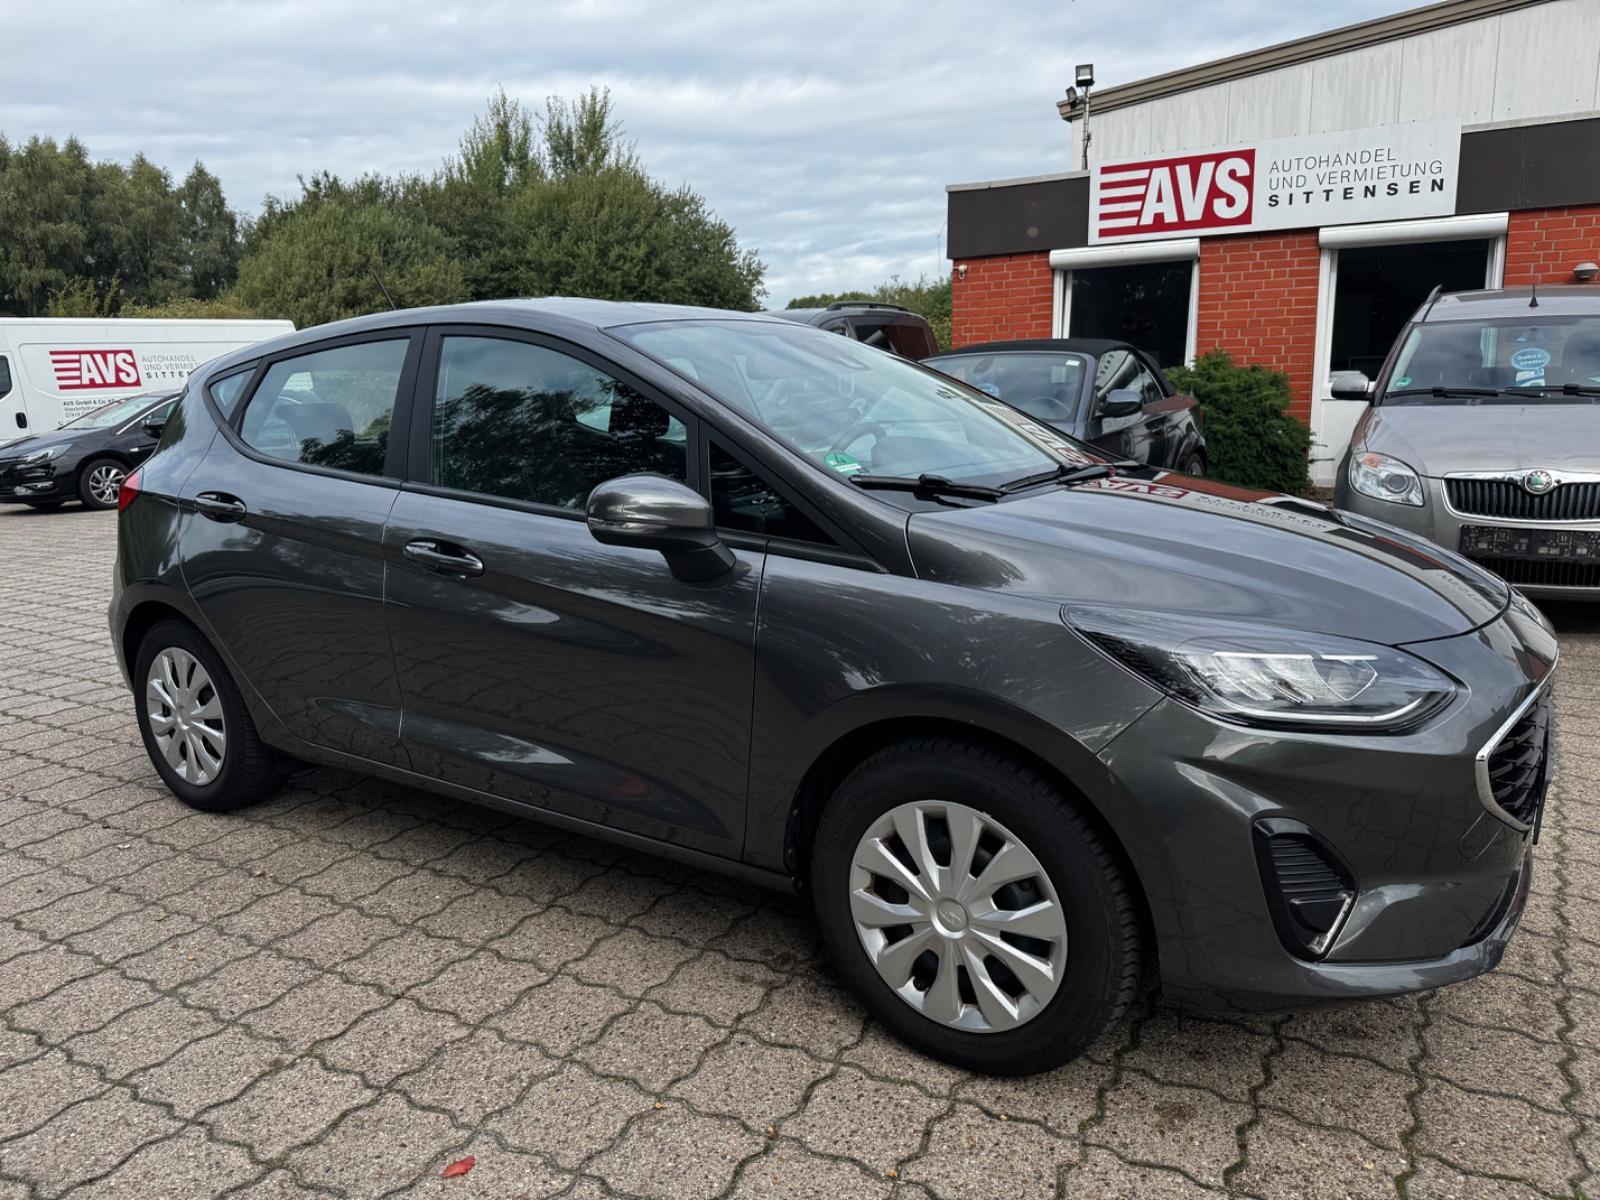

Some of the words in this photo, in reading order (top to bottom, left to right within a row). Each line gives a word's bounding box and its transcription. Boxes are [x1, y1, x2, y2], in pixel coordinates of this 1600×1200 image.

[1269, 148, 1396, 174] AUTOHANDEL
[1269, 174, 1308, 191] UND
[1316, 160, 1443, 186] VERMIETUNG
[1139, 157, 1250, 226] AVS
[1268, 178, 1444, 207] SITTENSEN
[81, 352, 138, 385] AVS
[142, 354, 195, 363] AUTOHANDEL
[144, 363, 161, 371] UND
[165, 362, 199, 370] VERMIET
